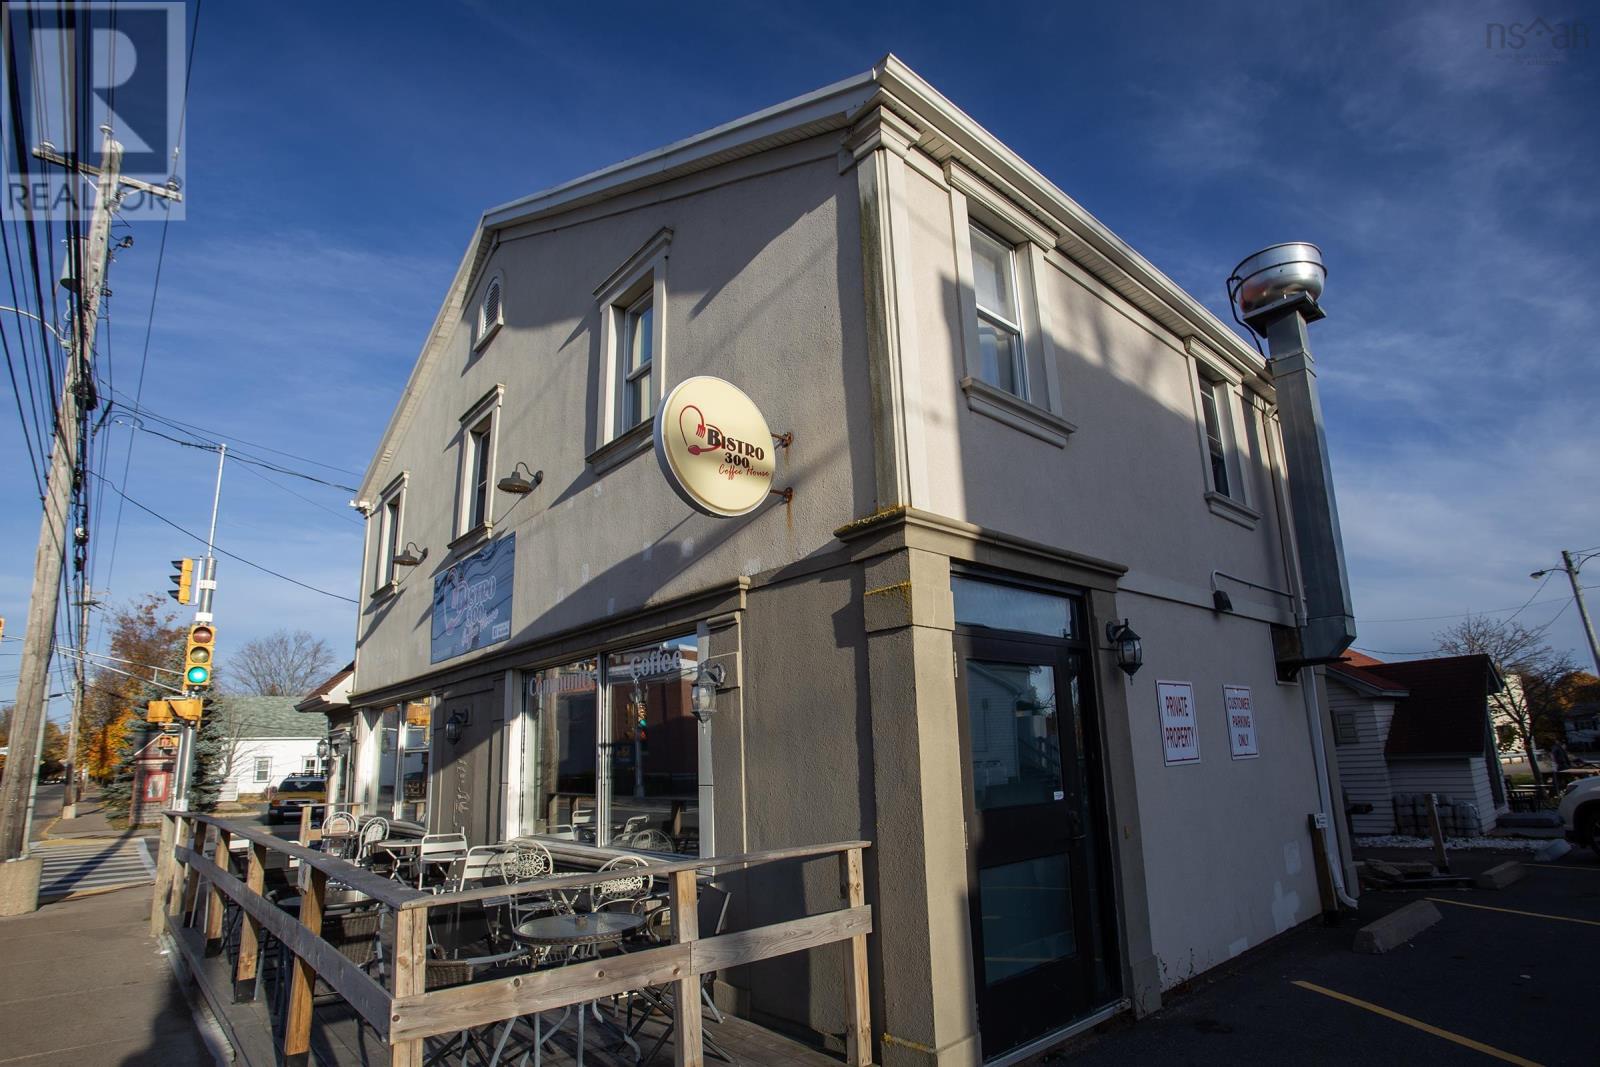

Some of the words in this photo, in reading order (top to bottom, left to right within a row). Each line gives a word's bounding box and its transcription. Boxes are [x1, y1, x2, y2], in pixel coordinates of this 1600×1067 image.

[707, 428, 765, 461] BISTRO
[725, 452, 750, 468] 300
[719, 463, 743, 480] Coffee
[746, 465, 770, 477] House
[630, 650, 682, 679] Coffee
[1166, 696, 1188, 717] PRIVATE
[1165, 726, 1195, 748] PROPERTY
